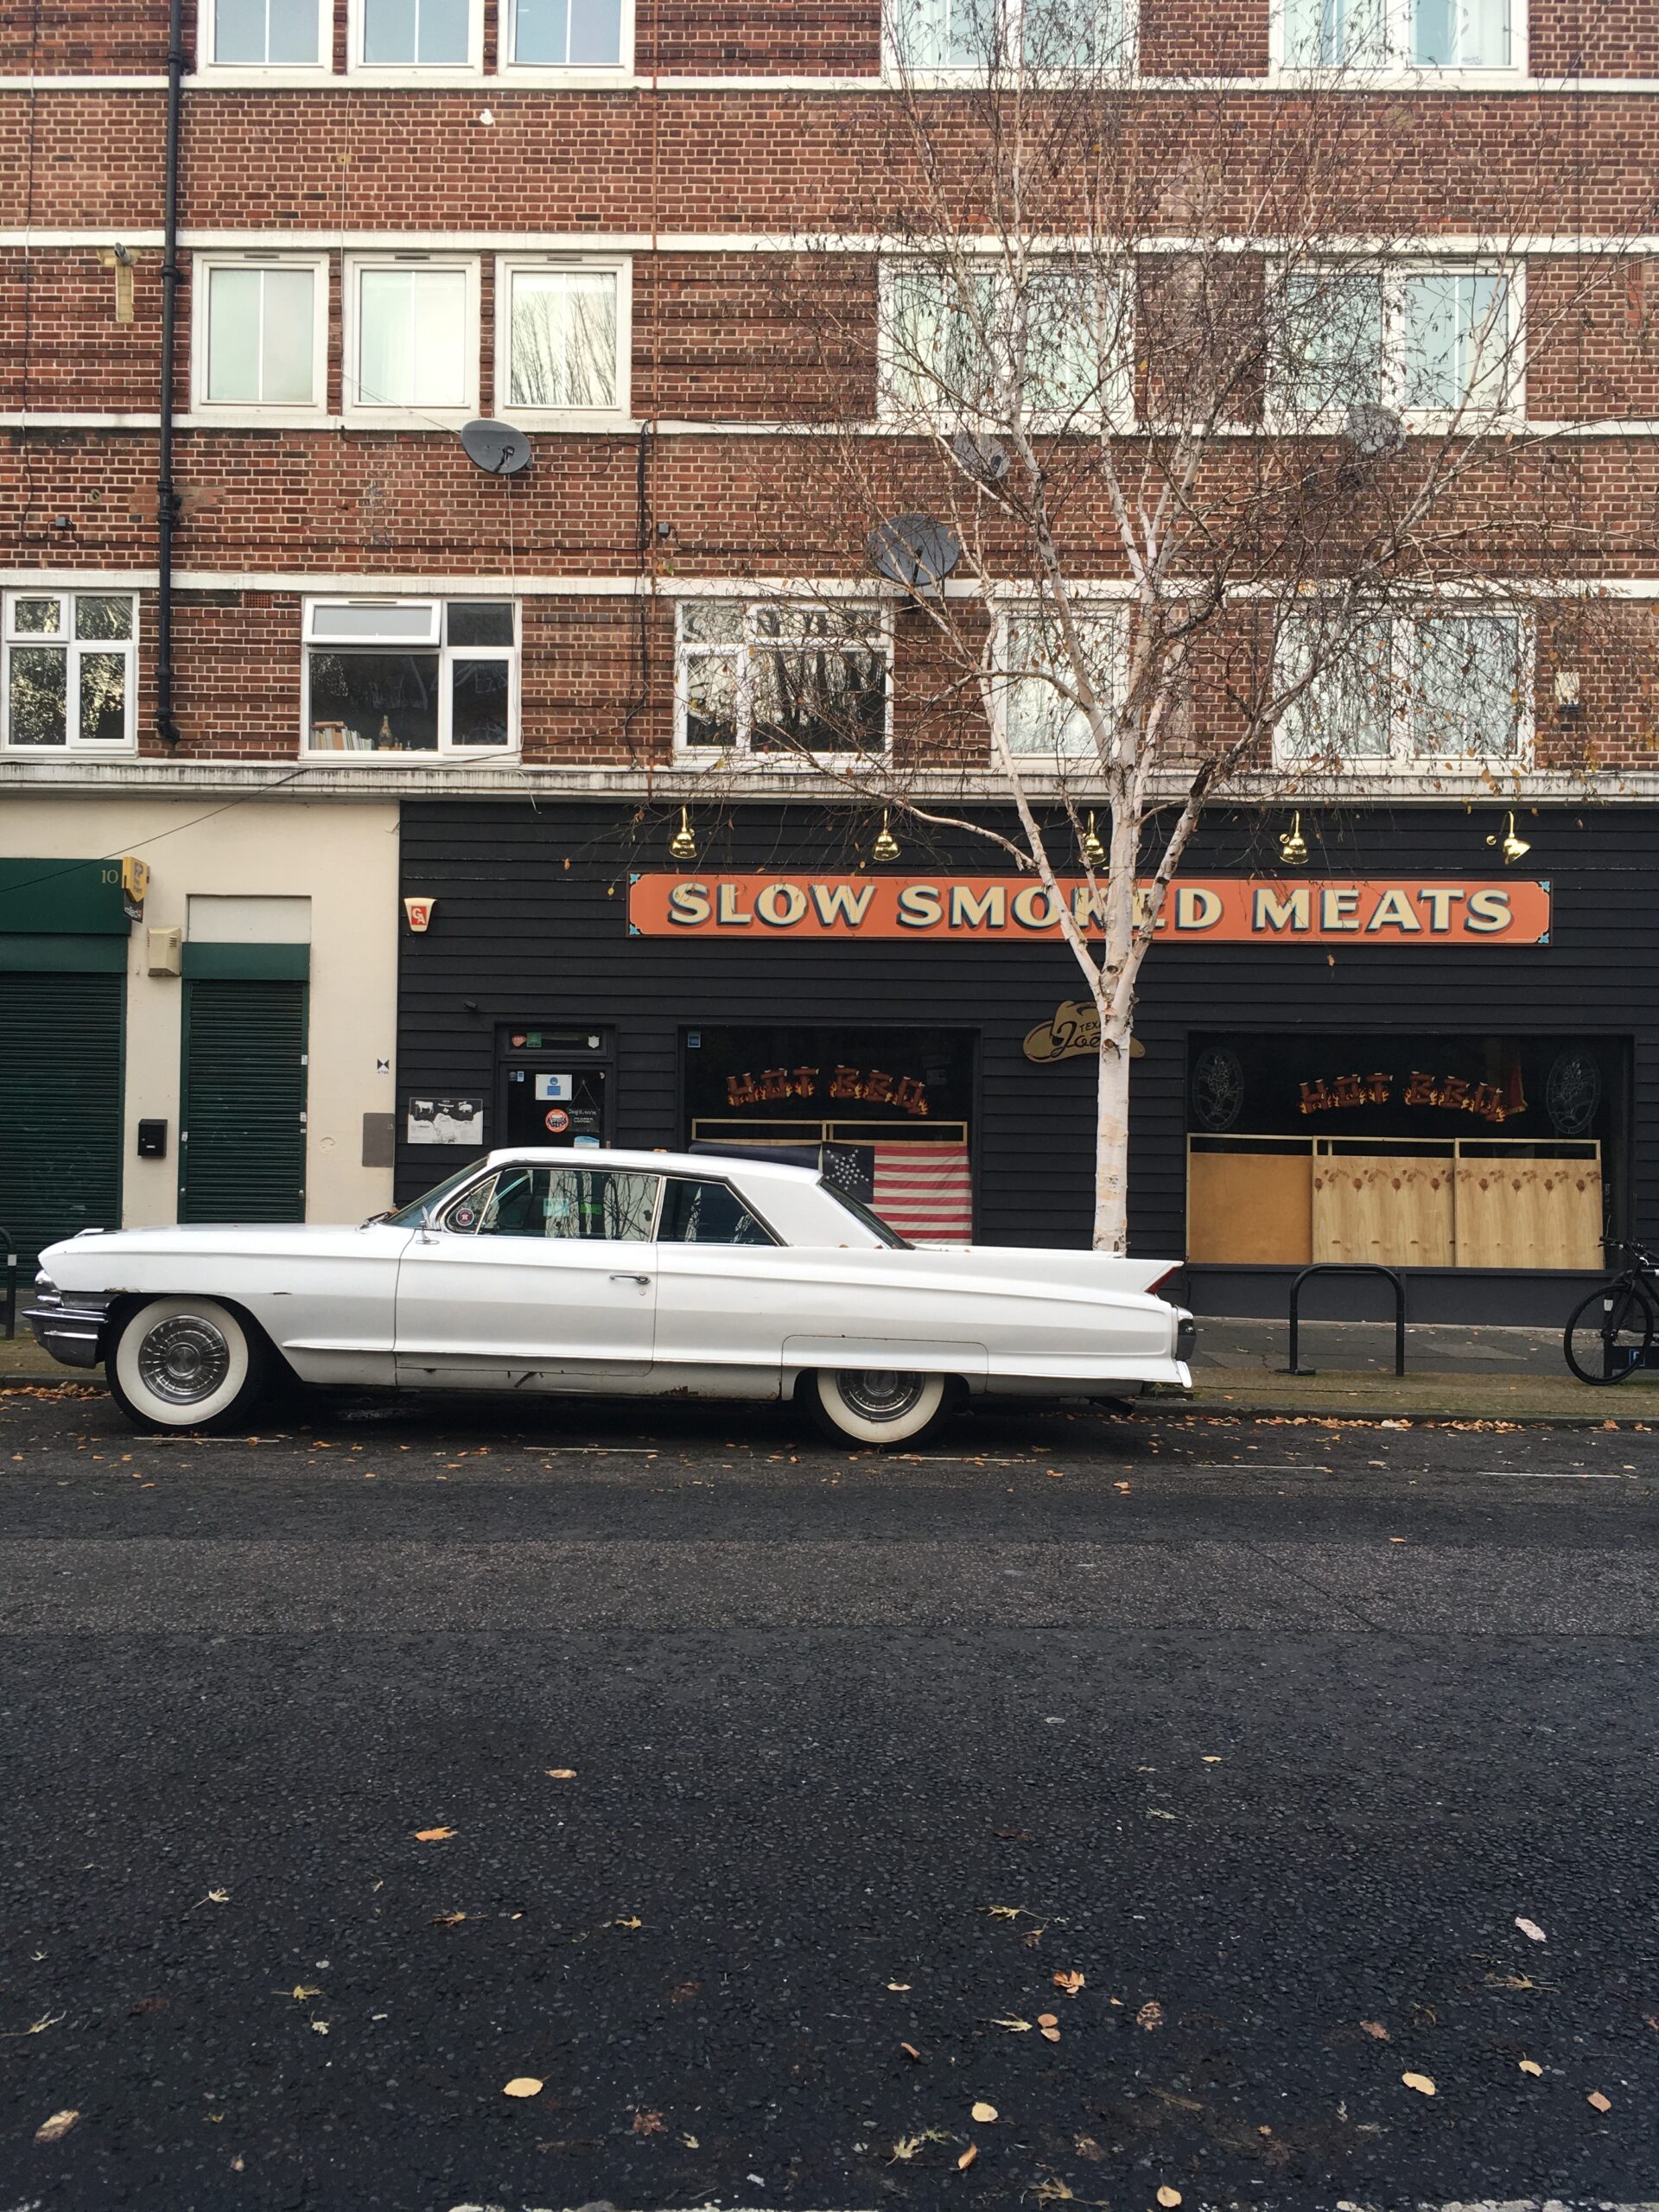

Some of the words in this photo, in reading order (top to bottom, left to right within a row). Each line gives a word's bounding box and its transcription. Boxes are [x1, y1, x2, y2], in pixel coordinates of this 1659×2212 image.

[101, 869, 118, 884] 10
[668, 882, 876, 927] SLOW
[1252, 888, 1512, 932] MEATS
[1080, 1021, 1101, 1033] TEX
[728, 1066, 819, 1106] HOT
[829, 1065, 928, 1116] BBQ
[1299, 1072, 1394, 1114] HOT
[1403, 1071, 1506, 1122] BBQ
